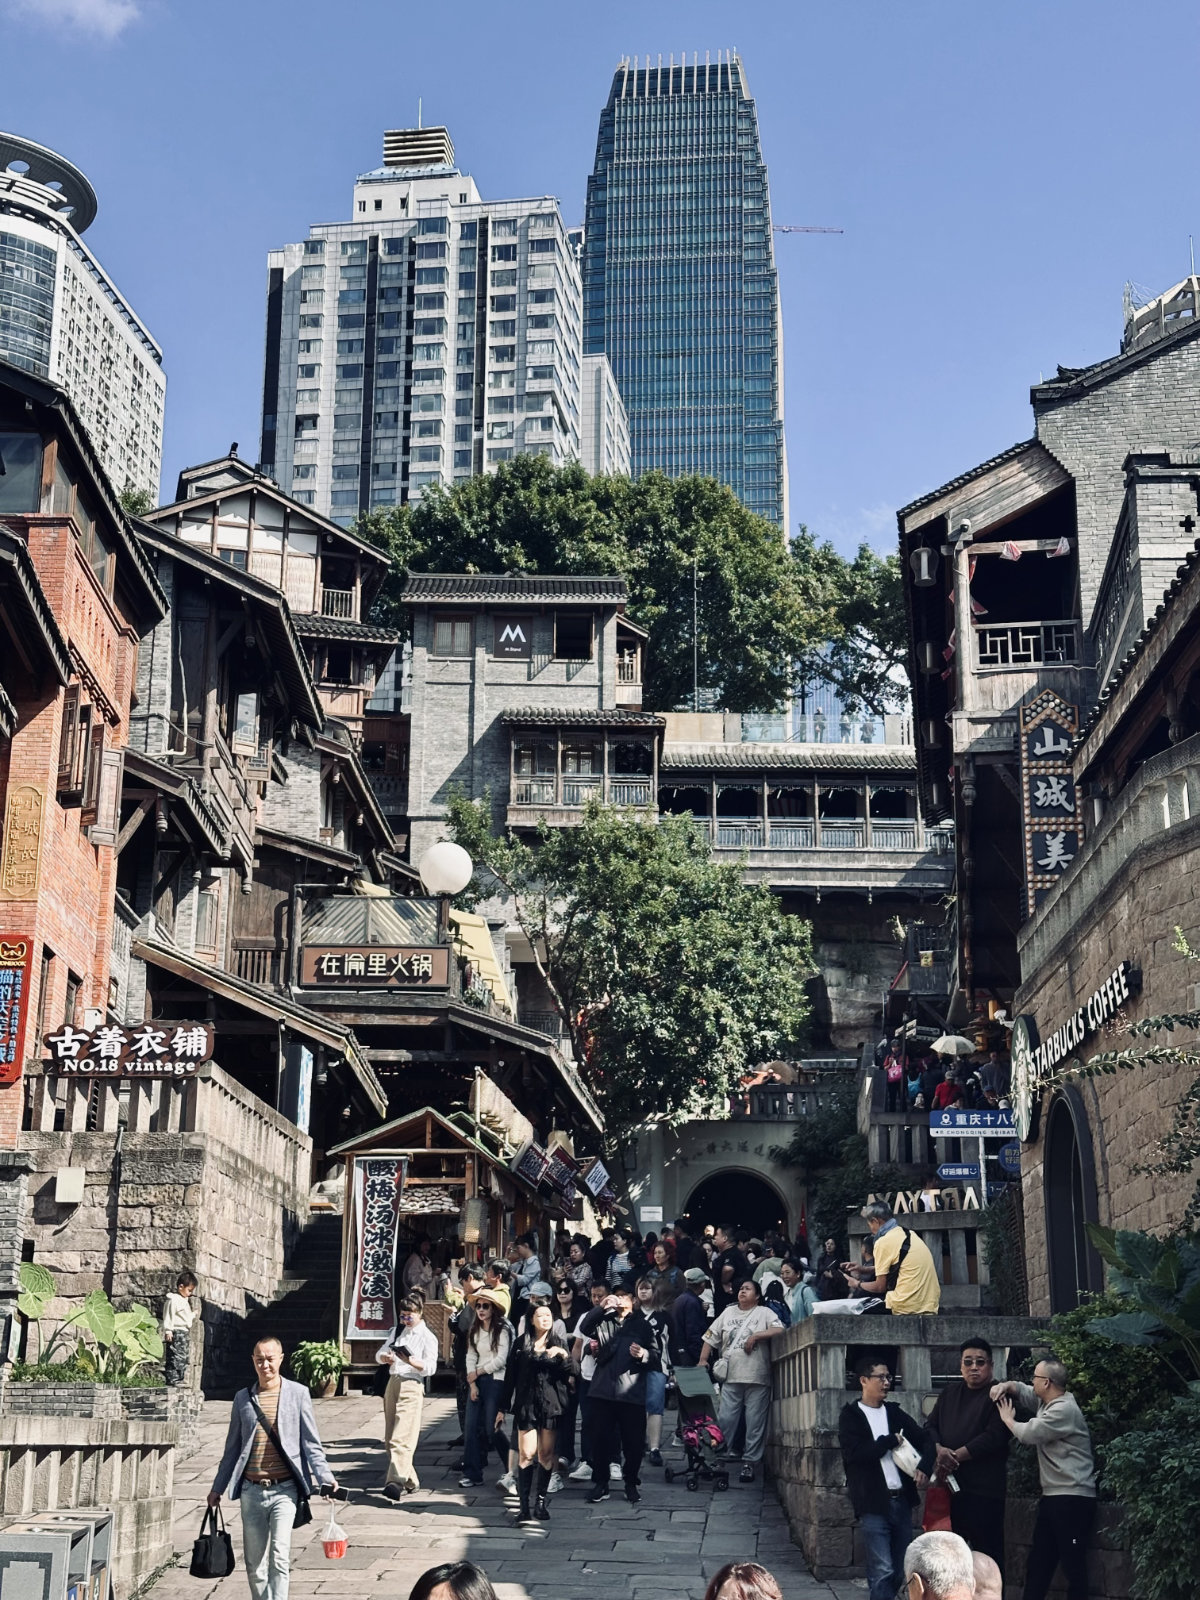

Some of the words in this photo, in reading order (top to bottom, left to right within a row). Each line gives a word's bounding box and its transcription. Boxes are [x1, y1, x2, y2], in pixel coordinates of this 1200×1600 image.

[17, 795, 40, 886] 小城故事
[1034, 727, 1075, 871] 山城美
[48, 1025, 209, 1059] 古着衣铺
[63, 1058, 119, 1072] NO.18
[124, 1058, 196, 1075] vintage
[1028, 1007, 1085, 1081] STARBUCKS
[1087, 962, 1129, 1030] COFFEE
[361, 1160, 398, 1298] 酸梅汤冰激凌
